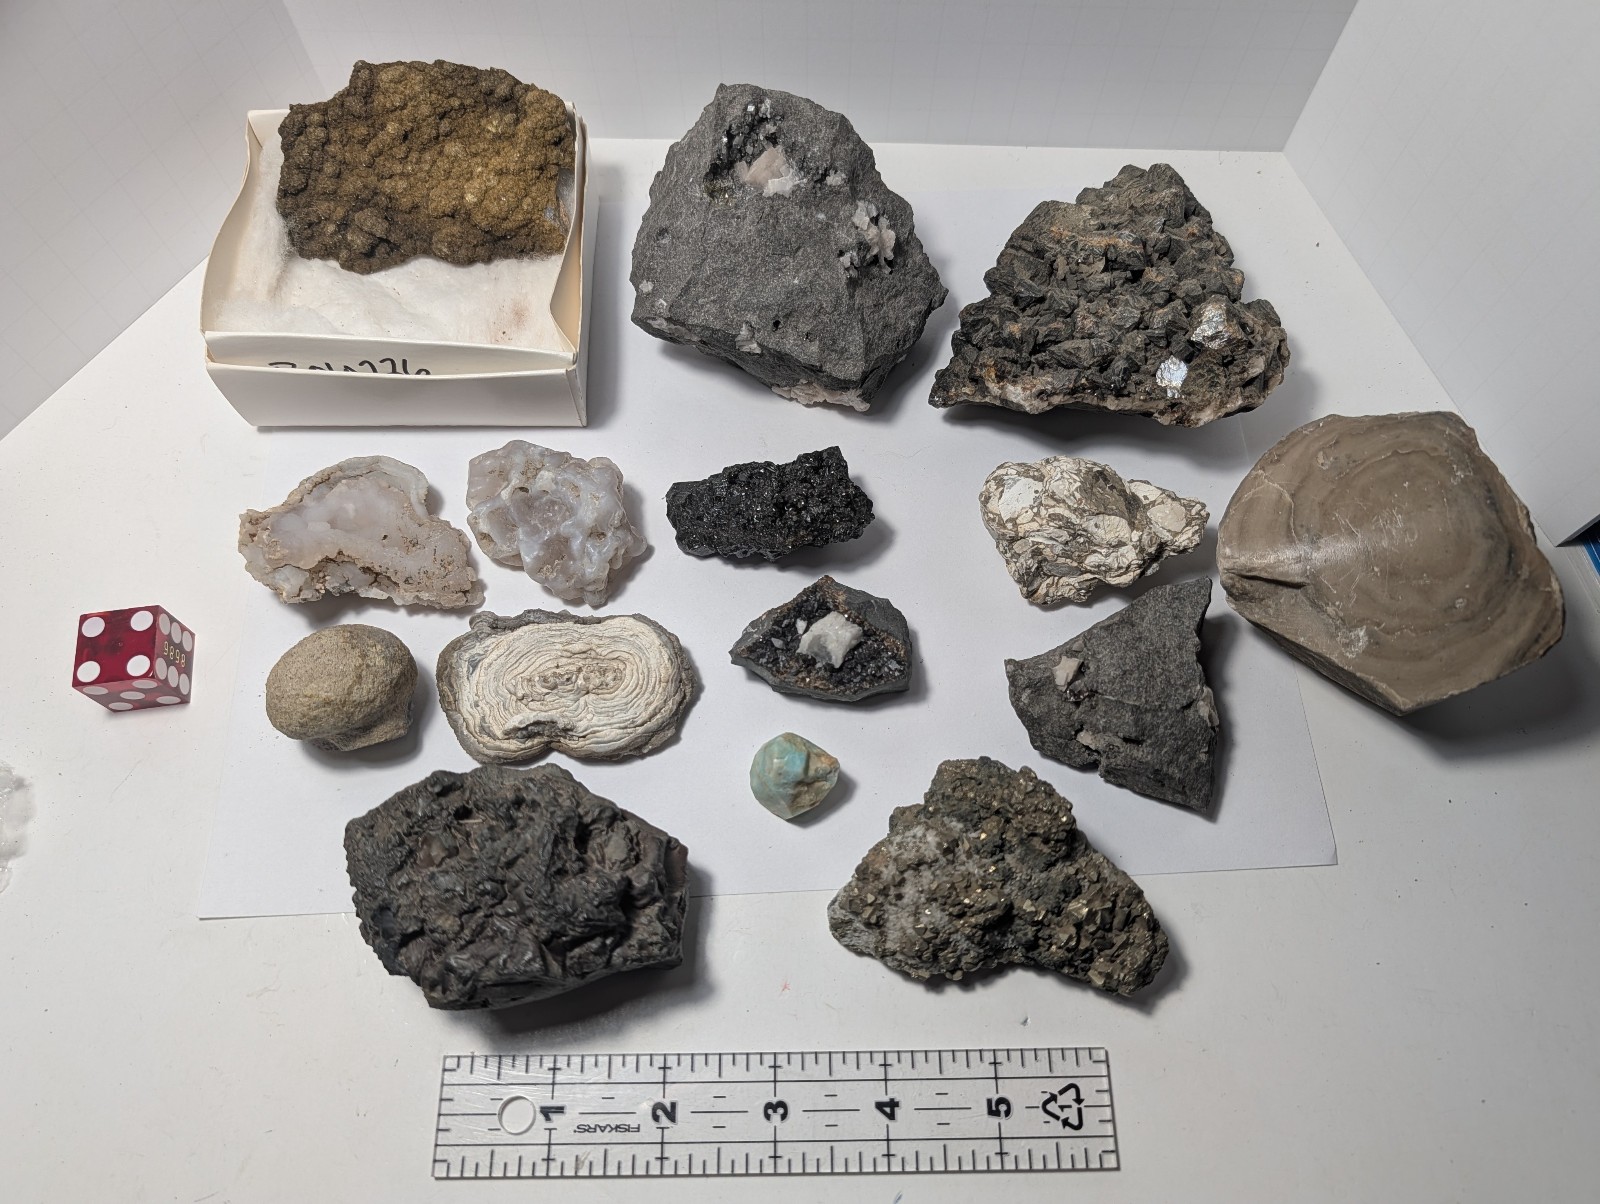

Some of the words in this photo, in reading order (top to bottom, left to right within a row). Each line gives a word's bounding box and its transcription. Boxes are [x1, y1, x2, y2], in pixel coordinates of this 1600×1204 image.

[540, 1105, 566, 1122] 1
[651, 1101, 677, 1124] 2
[763, 1100, 788, 1122] 3
[875, 1097, 900, 1121] 4
[986, 1096, 1011, 1118] 5
[573, 1123, 641, 1133] FISKARS
